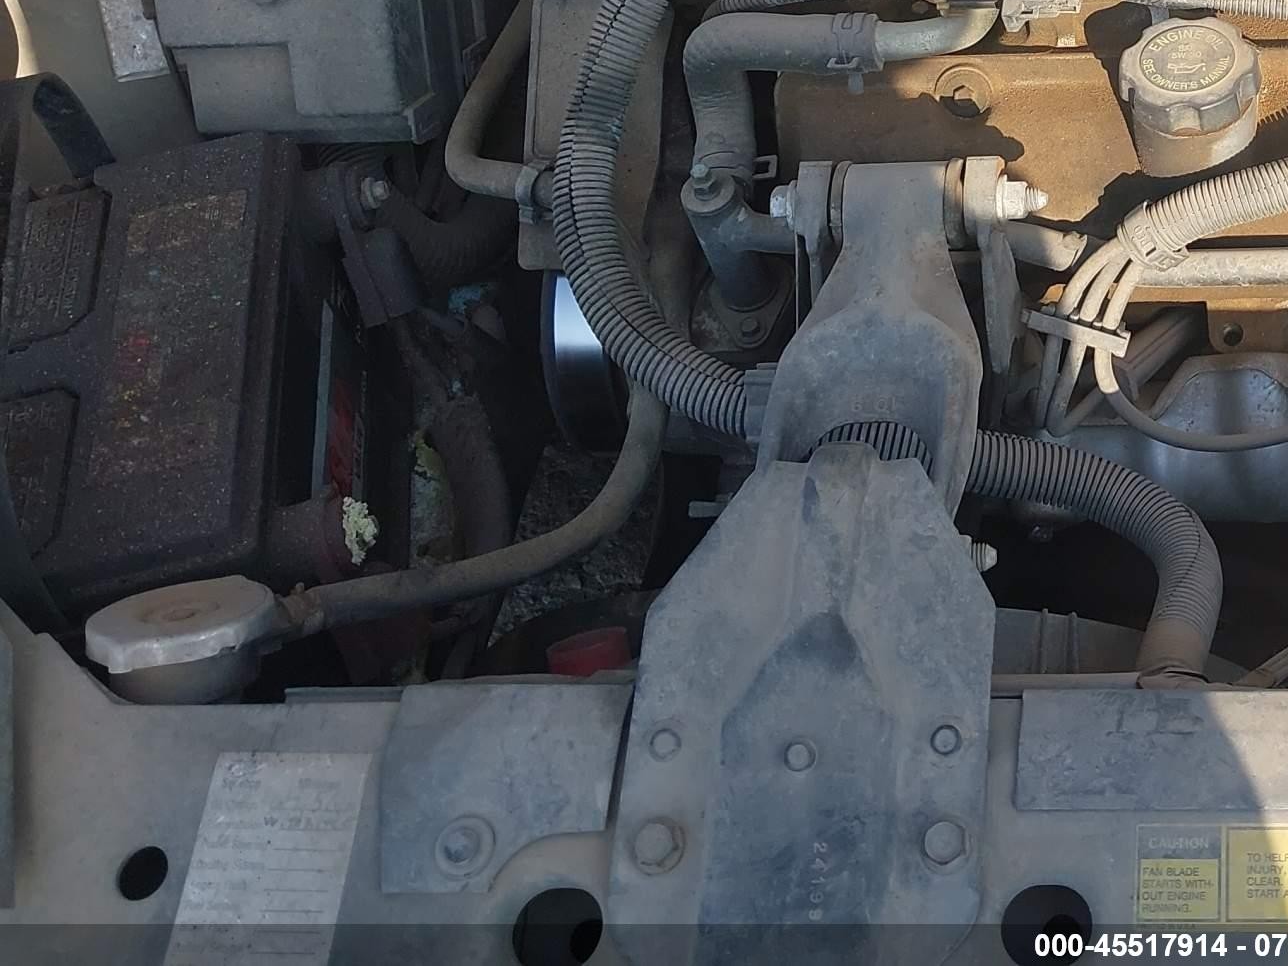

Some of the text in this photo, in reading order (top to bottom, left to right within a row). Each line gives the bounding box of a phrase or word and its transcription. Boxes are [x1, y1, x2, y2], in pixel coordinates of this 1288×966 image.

[1148, 28, 1226, 53] ENGINE OIL
[1141, 55, 1232, 91] SEE OWNER'S MANUAL
[1148, 836, 1209, 850] CAUTION
[1247, 852, 1261, 863] TO
[1142, 867, 1200, 877] FAN BLADE
[1246, 864, 1287, 876] INJURY,
[1142, 879, 1215, 889] STARTS WITH-
[1142, 891, 1208, 901] OUT ENGINE
[1246, 888, 1280, 899] START
[1142, 903, 1193, 914] RUNNING.
